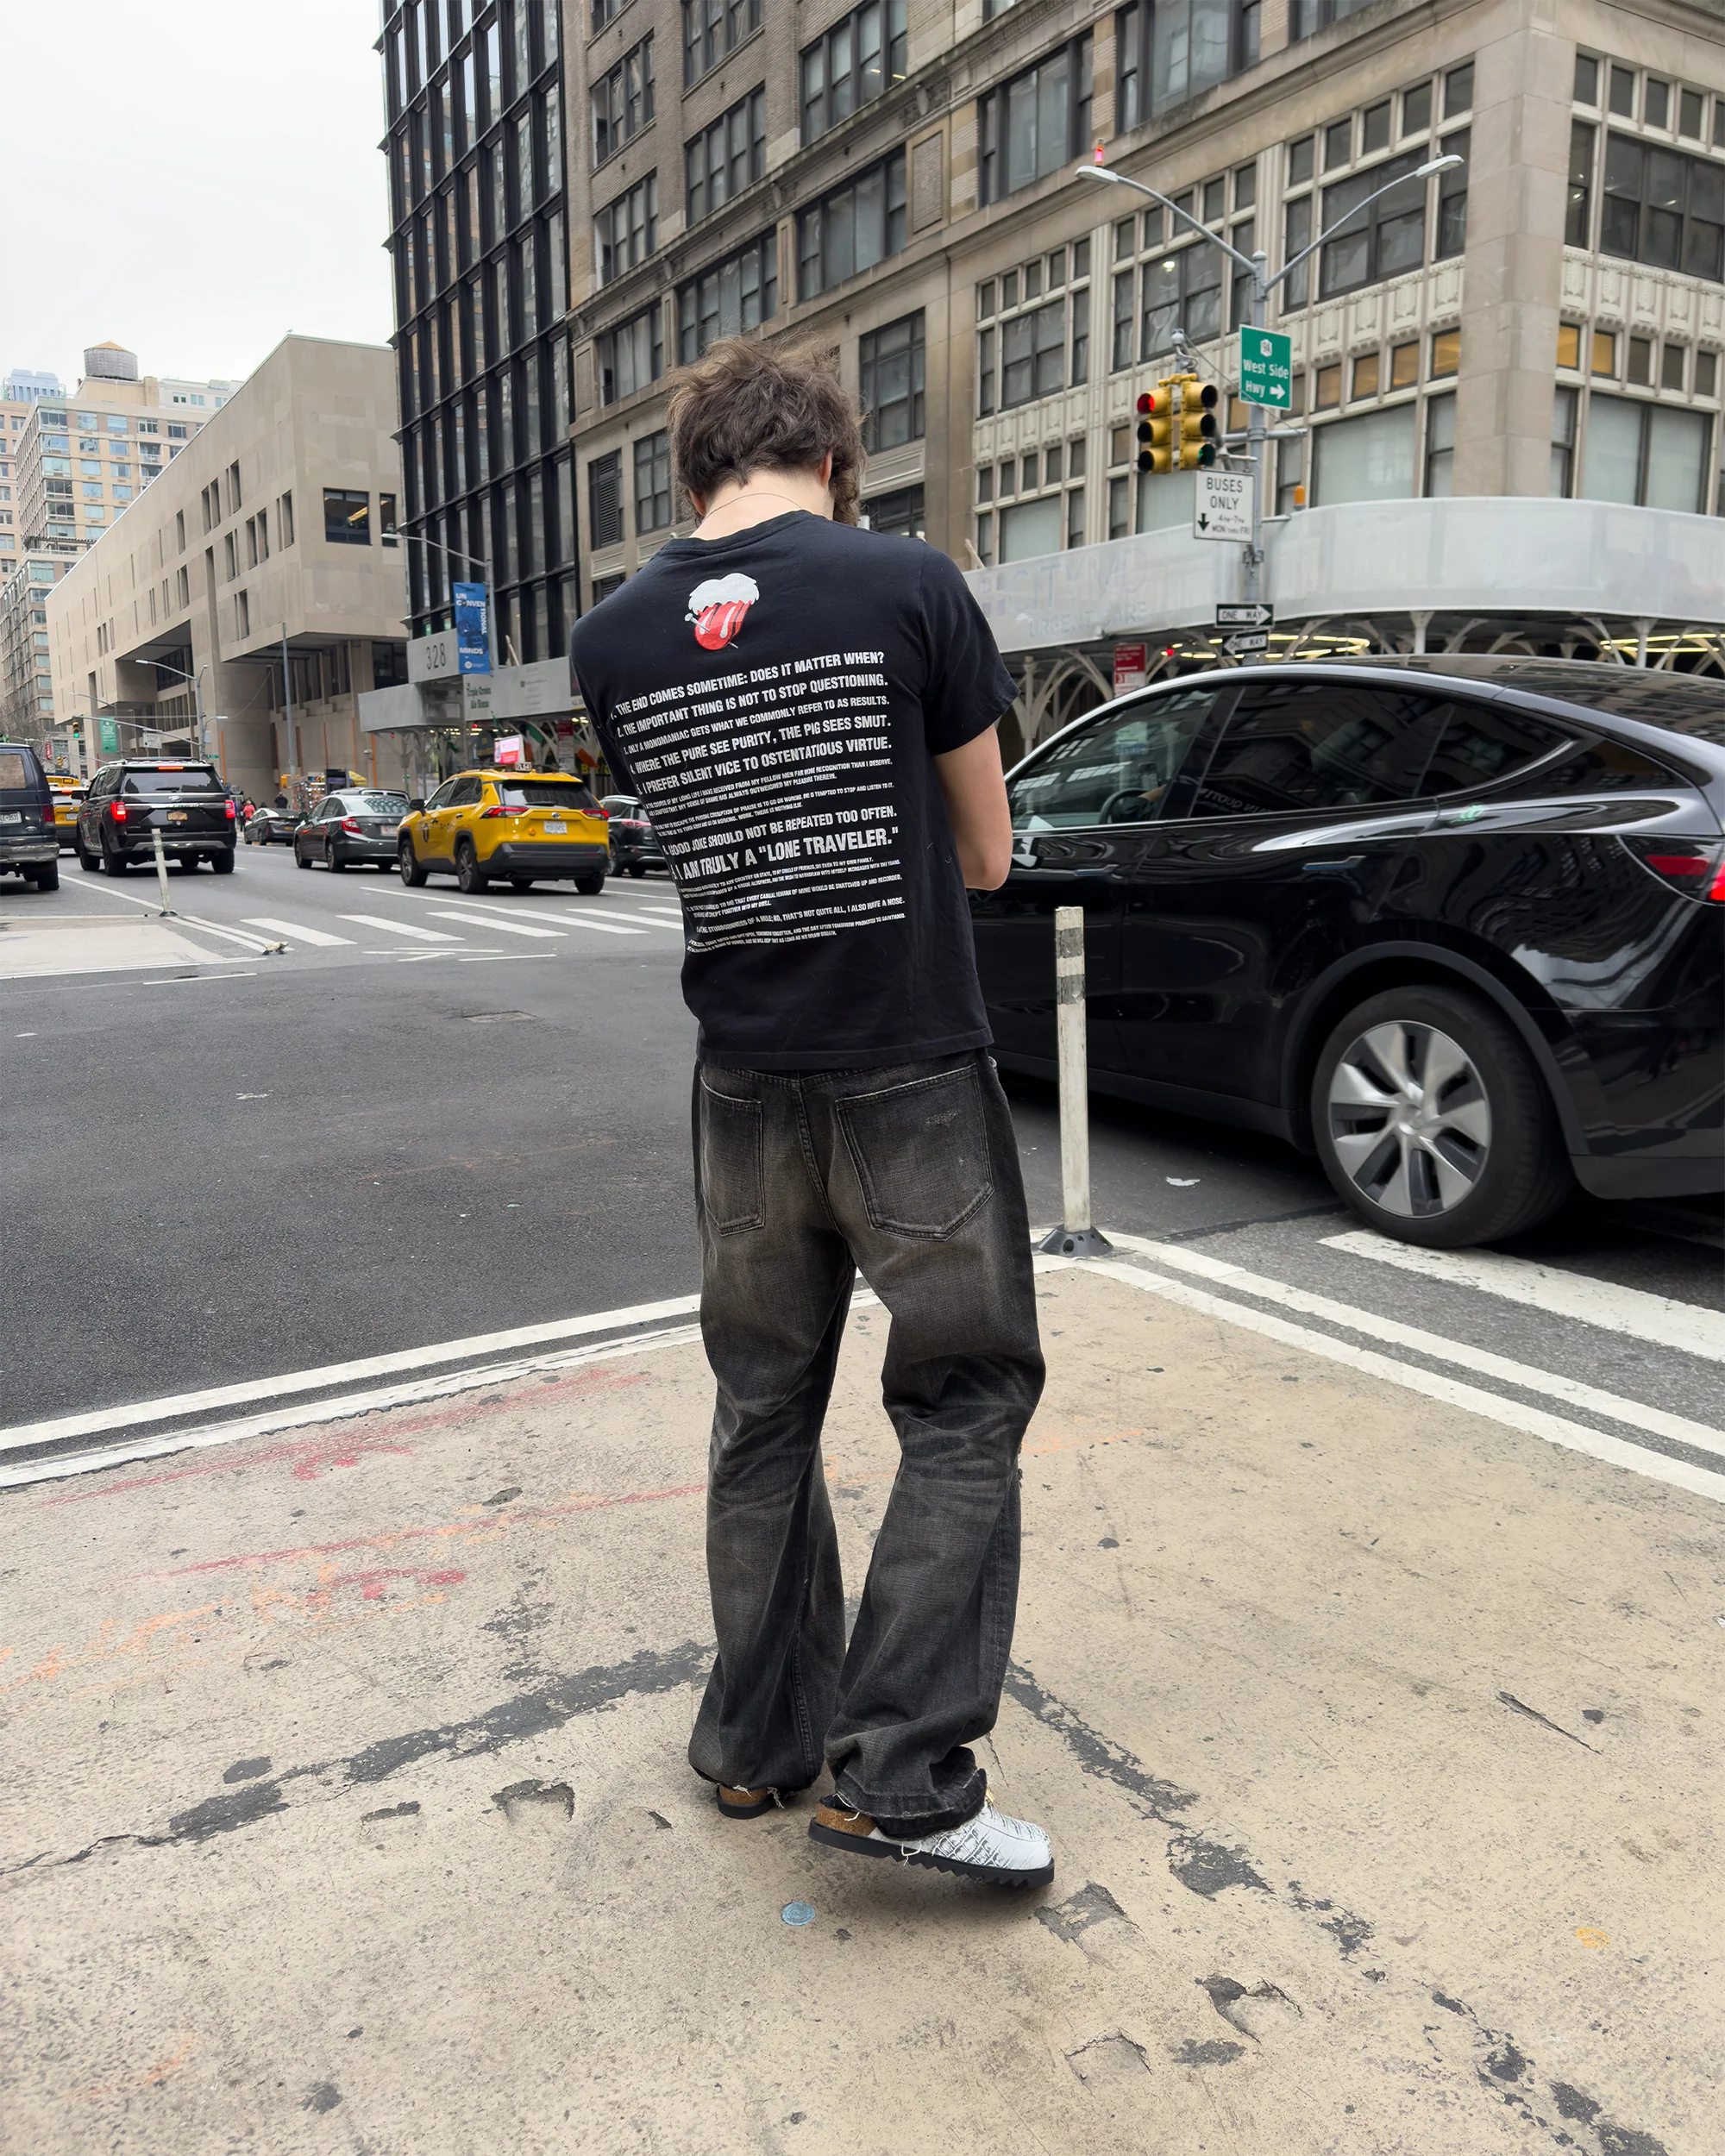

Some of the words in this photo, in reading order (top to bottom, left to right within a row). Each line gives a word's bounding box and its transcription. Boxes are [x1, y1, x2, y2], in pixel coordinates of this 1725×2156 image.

[1243, 359, 1266, 374] West
[1269, 363, 1289, 379] Side
[1245, 379, 1265, 398] Hwy
[1207, 477, 1243, 492] BUSES
[1210, 495, 1239, 511] ONLY
[1212, 524, 1226, 533] MON
[1240, 526, 1251, 536] FRI
[1222, 611, 1238, 620] ONE
[1246, 611, 1264, 619] WAY
[1230, 640, 1242, 650] ONE
[1249, 637, 1264, 647] WAY
[426, 642, 447, 670] 328
[616, 701, 632, 718] THE
[631, 695, 648, 711] END
[649, 686, 685, 705] COMES
[687, 673, 748, 695] SOMETIME:
[750, 666, 779, 682] DOES
[781, 662, 791, 676] IT
[794, 654, 841, 673] MATTER
[844, 651, 884, 664] WHEN?
[623, 722, 637, 736] THE
[637, 706, 689, 731] IMPORTANT
[691, 699, 724, 717] THING
[725, 696, 737, 710] IS
[738, 691, 759, 707] NOT
[762, 688, 777, 702] TO
[779, 682, 807, 699] STOP
[810, 674, 888, 693] QUESTIONING.
[628, 743, 639, 754] ONLY
[639, 741, 644, 750] A
[643, 729, 690, 749] MONOMANIAC
[690, 724, 710, 736] GETS
[711, 719, 734, 732] WHAT
[735, 716, 749, 727] WE
[750, 706, 796, 724] COMMONLY
[797, 701, 824, 714] REFER
[824, 699, 835, 710] TO
[837, 697, 849, 708] AS
[850, 695, 890, 706] RESULTS.
[635, 756, 662, 773] WHERE
[661, 751, 681, 768] THE
[681, 744, 708, 761] PURE
[710, 739, 731, 755] SEE
[731, 730, 777, 749] PURITY,
[778, 724, 803, 740] THE
[803, 721, 821, 736] PIG
[823, 717, 852, 732] SEES
[854, 714, 891, 728] SMUT.
[761, 741, 844, 766] OSTENTATIOUS
[845, 736, 892, 752] VIRTUE.
[714, 760, 741, 776] VICE
[743, 755, 760, 770] TO
[645, 774, 681, 793] PREFER
[680, 766, 712, 784] SILENT
[713, 783, 735, 793] RECEIVED
[735, 780, 751, 789] FROM
[761, 774, 781, 783] FELLOW
[816, 762, 850, 773] RECOGNITION
[643, 781, 648, 793] I
[728, 788, 750, 799] ALWAYS
[750, 781, 783, 794] OUTWEIGHED
[793, 775, 813, 785] PLEASURE
[813, 773, 837, 781] THEREIN.
[692, 837, 708, 850] JOKE
[707, 830, 744, 847] SHOULD
[745, 824, 767, 839] NOT
[769, 820, 784, 834] BE
[785, 812, 834, 830] REPEATED
[835, 809, 859, 823] TOO
[861, 805, 897, 820] OFTEN.
[683, 860, 701, 879] AM
[700, 851, 739, 874] TRULY
[745, 848, 758, 866] A
[758, 839, 801, 861] "LONE
[803, 826, 899, 854] TRAVELER."
[746, 893, 760, 902] EVERY
[878, 874, 903, 882] RECORDED.
[708, 919, 749, 932] STUBBORNNESS
[782, 911, 803, 920] THAT'S
[816, 906, 833, 916] QUITE
[850, 903, 867, 912] ALSO
[867, 899, 881, 909] HAVE
[888, 896, 906, 906] NOSE.
